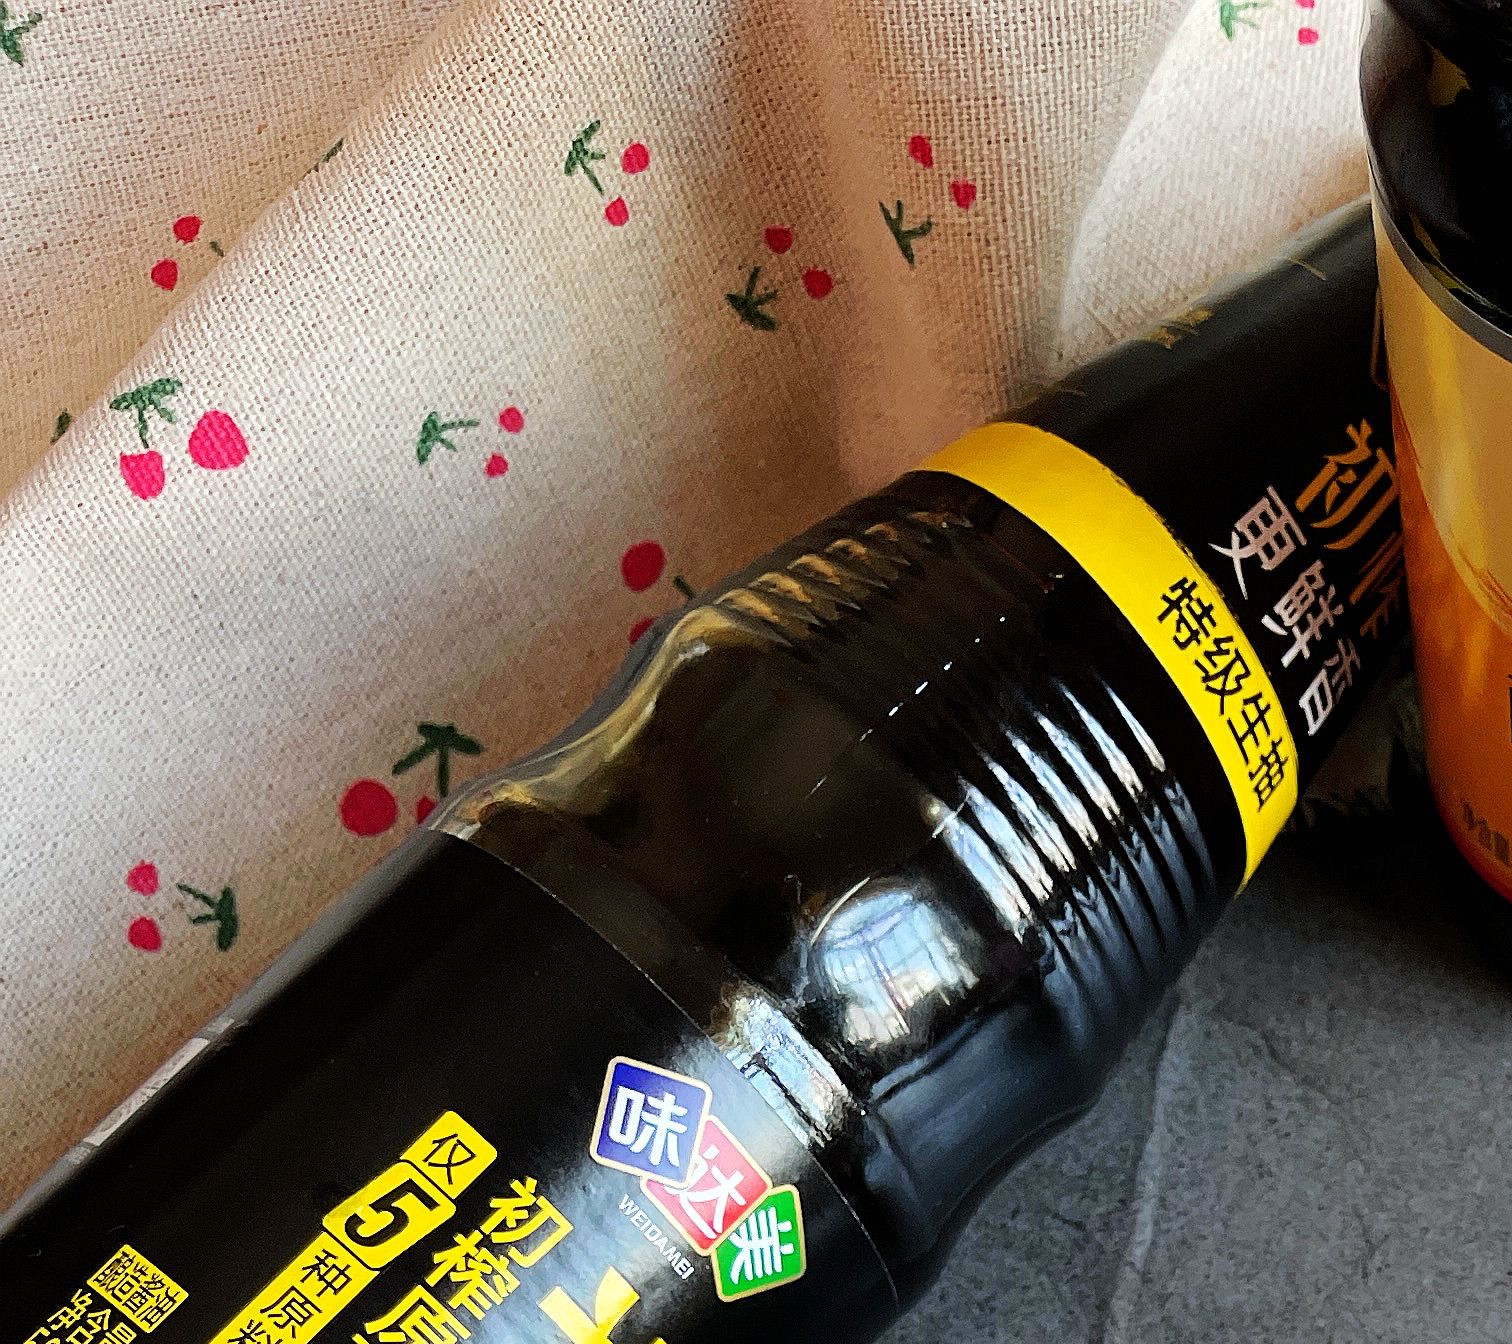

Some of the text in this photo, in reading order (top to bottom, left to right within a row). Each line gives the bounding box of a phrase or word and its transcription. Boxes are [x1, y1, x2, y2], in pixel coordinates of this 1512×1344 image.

[1156, 576, 1289, 812] 特级生抽
[608, 1085, 794, 1285] 味达美
[618, 1193, 695, 1281] WEIDAMEI
